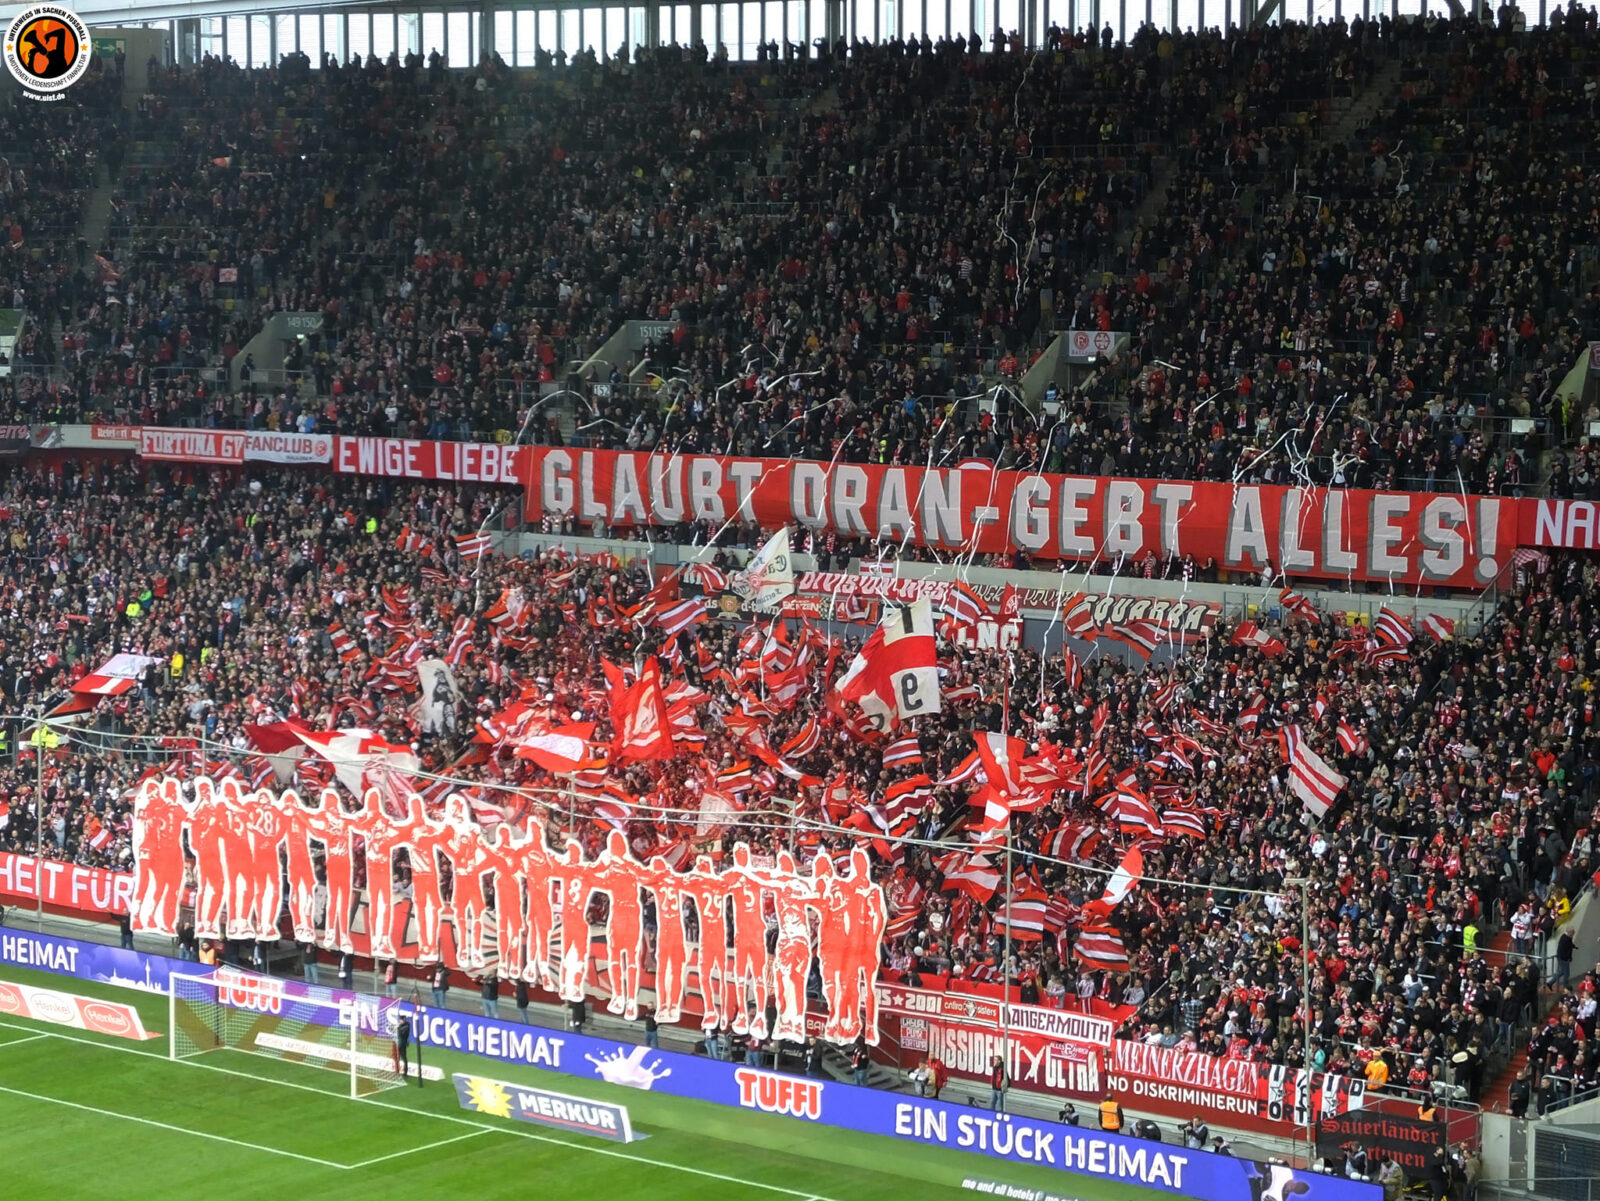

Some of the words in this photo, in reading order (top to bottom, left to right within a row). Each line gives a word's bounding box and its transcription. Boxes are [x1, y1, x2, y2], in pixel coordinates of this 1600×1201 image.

[142, 431, 217, 457] FORTUNA
[246, 436, 313, 455] FANCLUB
[339, 436, 423, 477] EWIGE
[434, 441, 520, 483] LIEBE
[541, 448, 763, 526] GLAUBT
[1225, 486, 1500, 582] ALLES!
[799, 571, 895, 597] DIVISION
[3, 935, 79, 972] HEIMAT
[87, 1008, 127, 1027] Henkel
[905, 992, 943, 1014] 2001
[467, 1023, 565, 1068] HEIMAT
[1115, 1038, 1258, 1098] MEINERZHAGEN
[518, 1091, 617, 1130] MERKUR
[735, 1067, 824, 1120] TUFFI
[895, 1103, 948, 1142] EIN
[957, 1113, 1055, 1164] STÜCK
[1064, 1135, 1188, 1189] HEIMAT
[1321, 1118, 1440, 1145] Sauerländer
[977, 1181, 995, 1193] and
[1006, 1186, 1035, 1200] hotels
